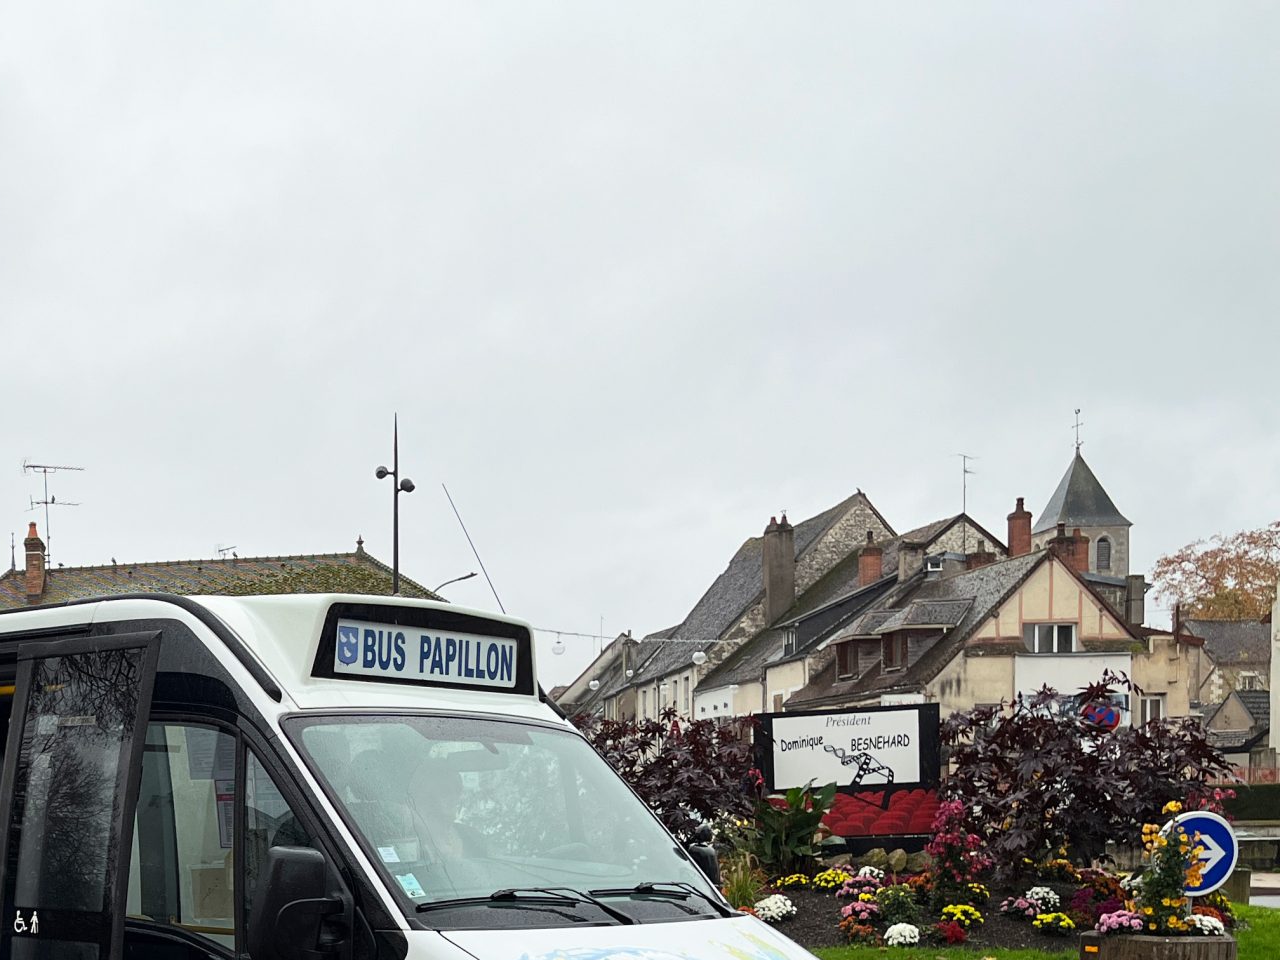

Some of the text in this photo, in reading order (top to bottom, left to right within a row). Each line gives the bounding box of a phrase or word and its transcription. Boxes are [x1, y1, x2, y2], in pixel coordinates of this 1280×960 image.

[363, 629, 513, 681] BUS PAPILLON
[825, 714, 871, 727] Président
[781, 733, 910, 752] Dominique BESNEHARD
